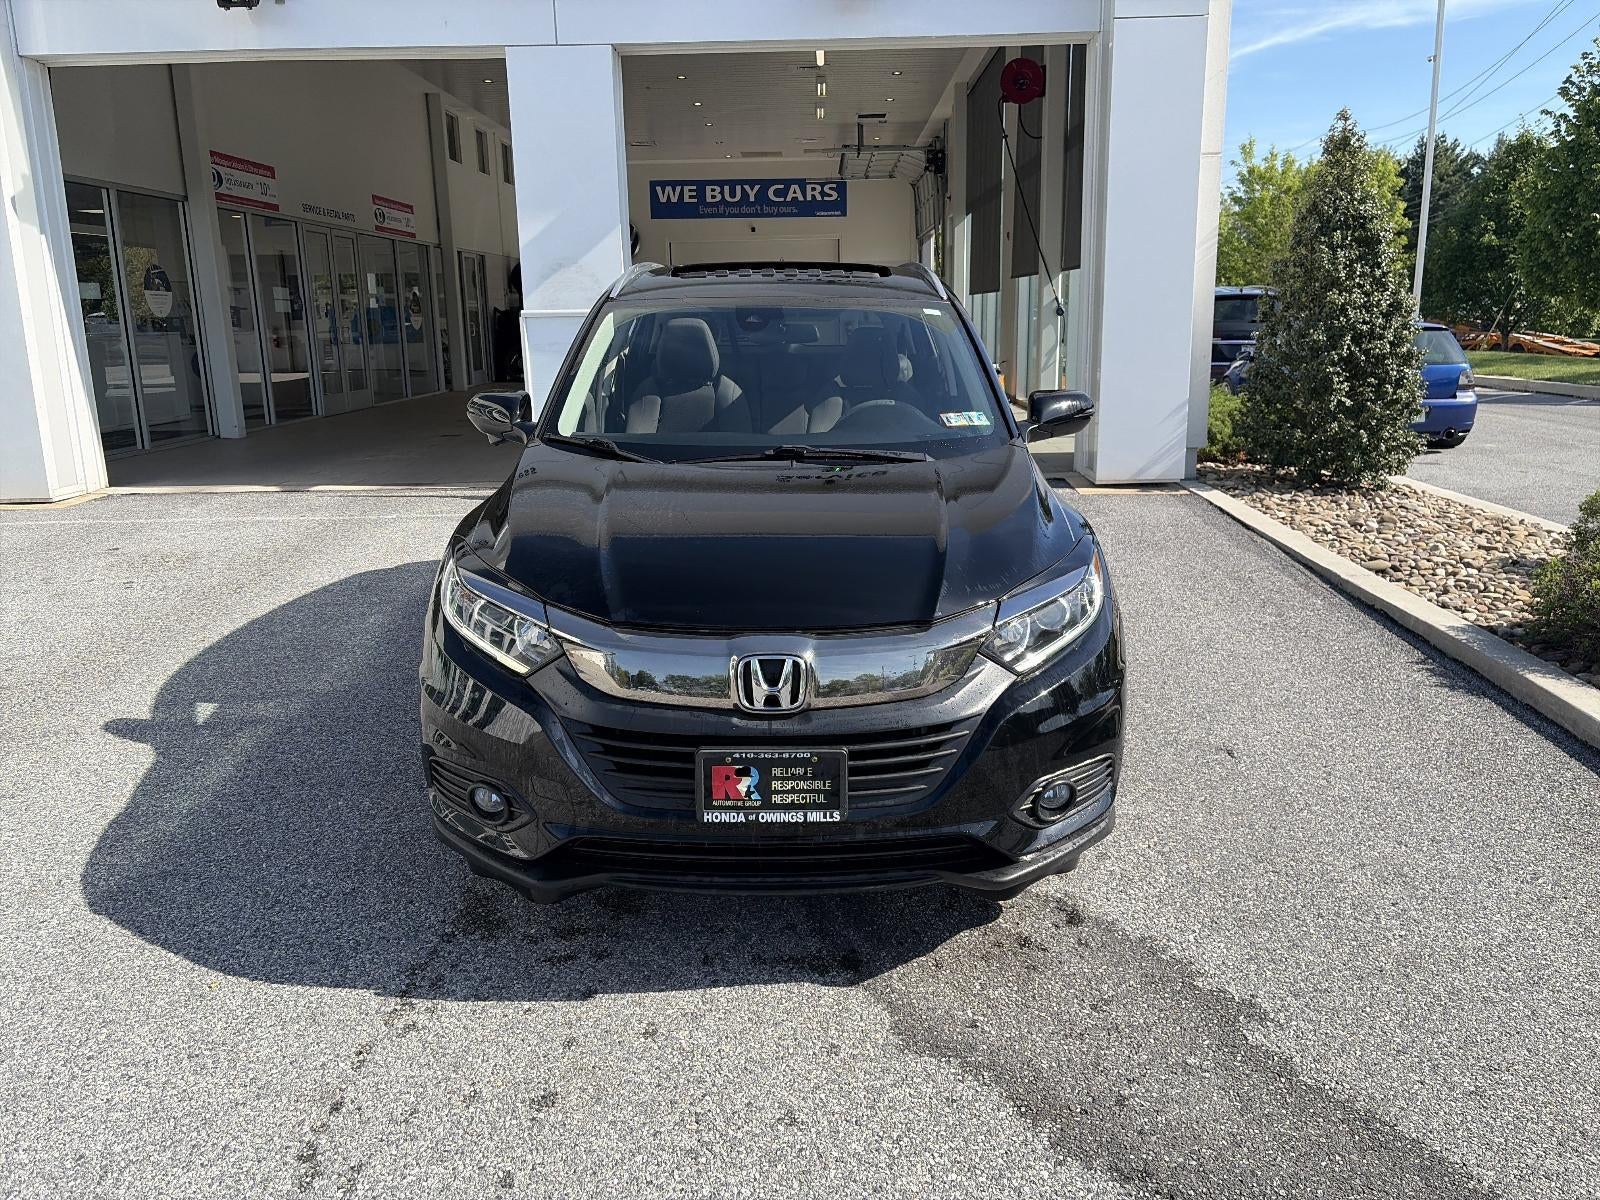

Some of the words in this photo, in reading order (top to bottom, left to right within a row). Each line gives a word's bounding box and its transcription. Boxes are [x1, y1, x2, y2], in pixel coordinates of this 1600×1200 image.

[655, 185, 698, 203] WE
[705, 184, 760, 203] BUY
[302, 202, 322, 215] SERVICE
[327, 208, 342, 220] RETAIL
[342, 211, 356, 222] PARTS
[699, 205, 718, 214] Even
[718, 204, 725, 214] if
[725, 206, 740, 215] you
[740, 204, 761, 214] don't
[763, 203, 778, 215] buy
[771, 780, 832, 791] RESPONSIBLE
[771, 793, 828, 804] RESPECTFUL
[703, 812, 746, 823] HONDA
[748, 813, 757, 821] of
[758, 811, 805, 823] OWINGS
[806, 811, 841, 823] MILLS
